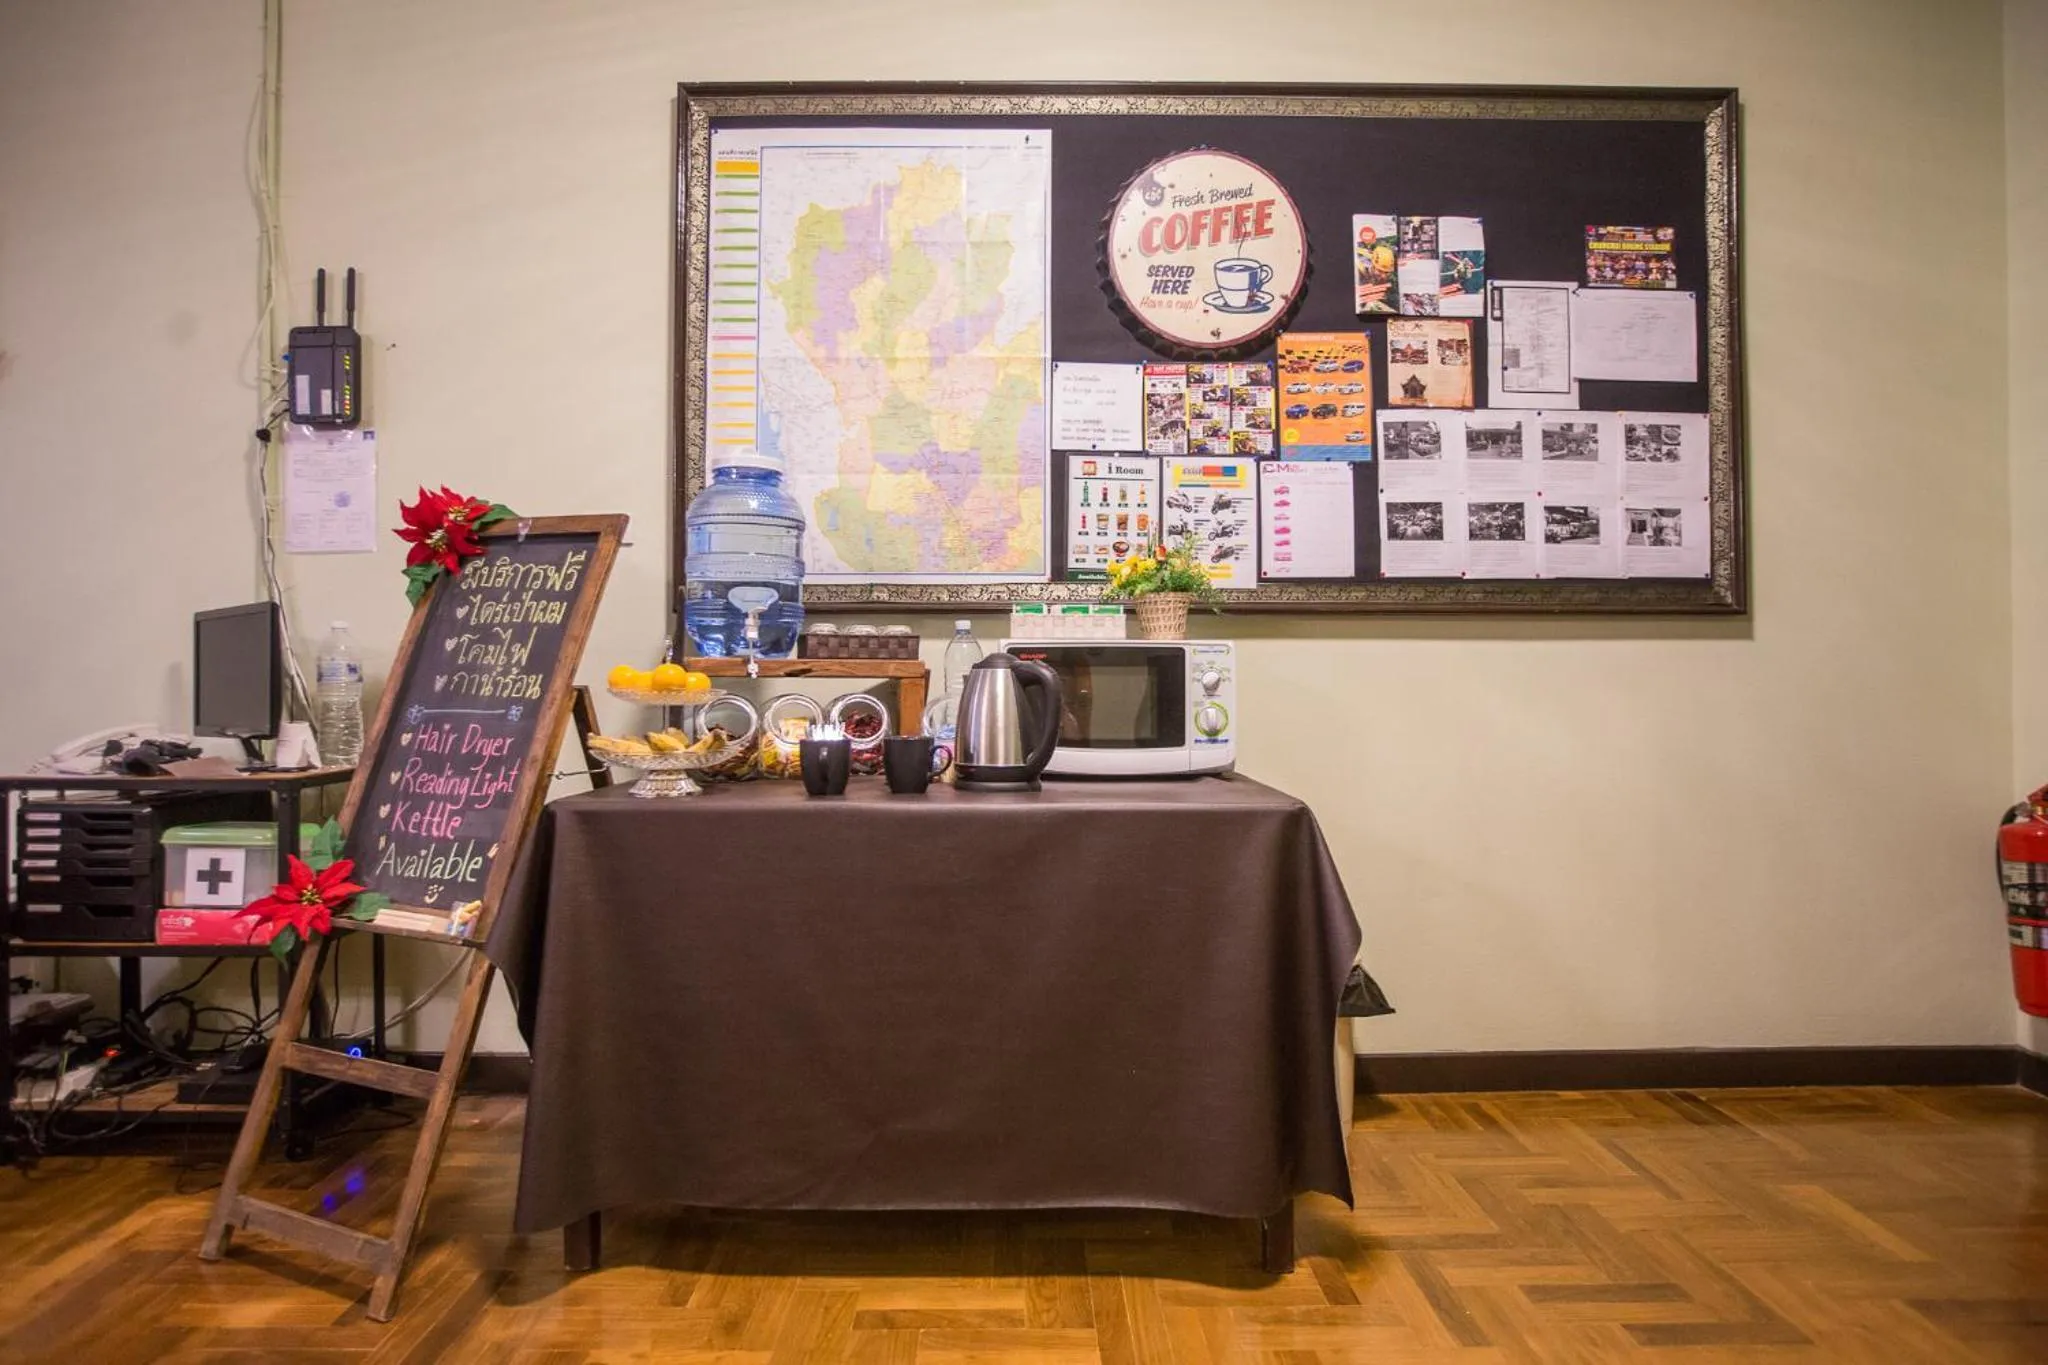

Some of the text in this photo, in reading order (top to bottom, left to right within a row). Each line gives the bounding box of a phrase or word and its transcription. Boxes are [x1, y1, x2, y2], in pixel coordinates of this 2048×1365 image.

[1171, 190, 1205, 209] Fresh
[1207, 183, 1254, 204] Brewed
[1138, 199, 1276, 258] COFFEE
[1146, 264, 1196, 279] SERVED
[1150, 279, 1192, 296] HERE
[1115, 466, 1144, 475] Room
[460, 551, 587, 592] มีบริการฟรี
[457, 626, 538, 667] โคมไฟ
[449, 665, 544, 700] กาน้ำร้อน
[414, 723, 515, 771] Hair Dryer
[399, 757, 522, 810] Reading Light
[390, 801, 464, 839] Kettle
[375, 839, 483, 883] Available
